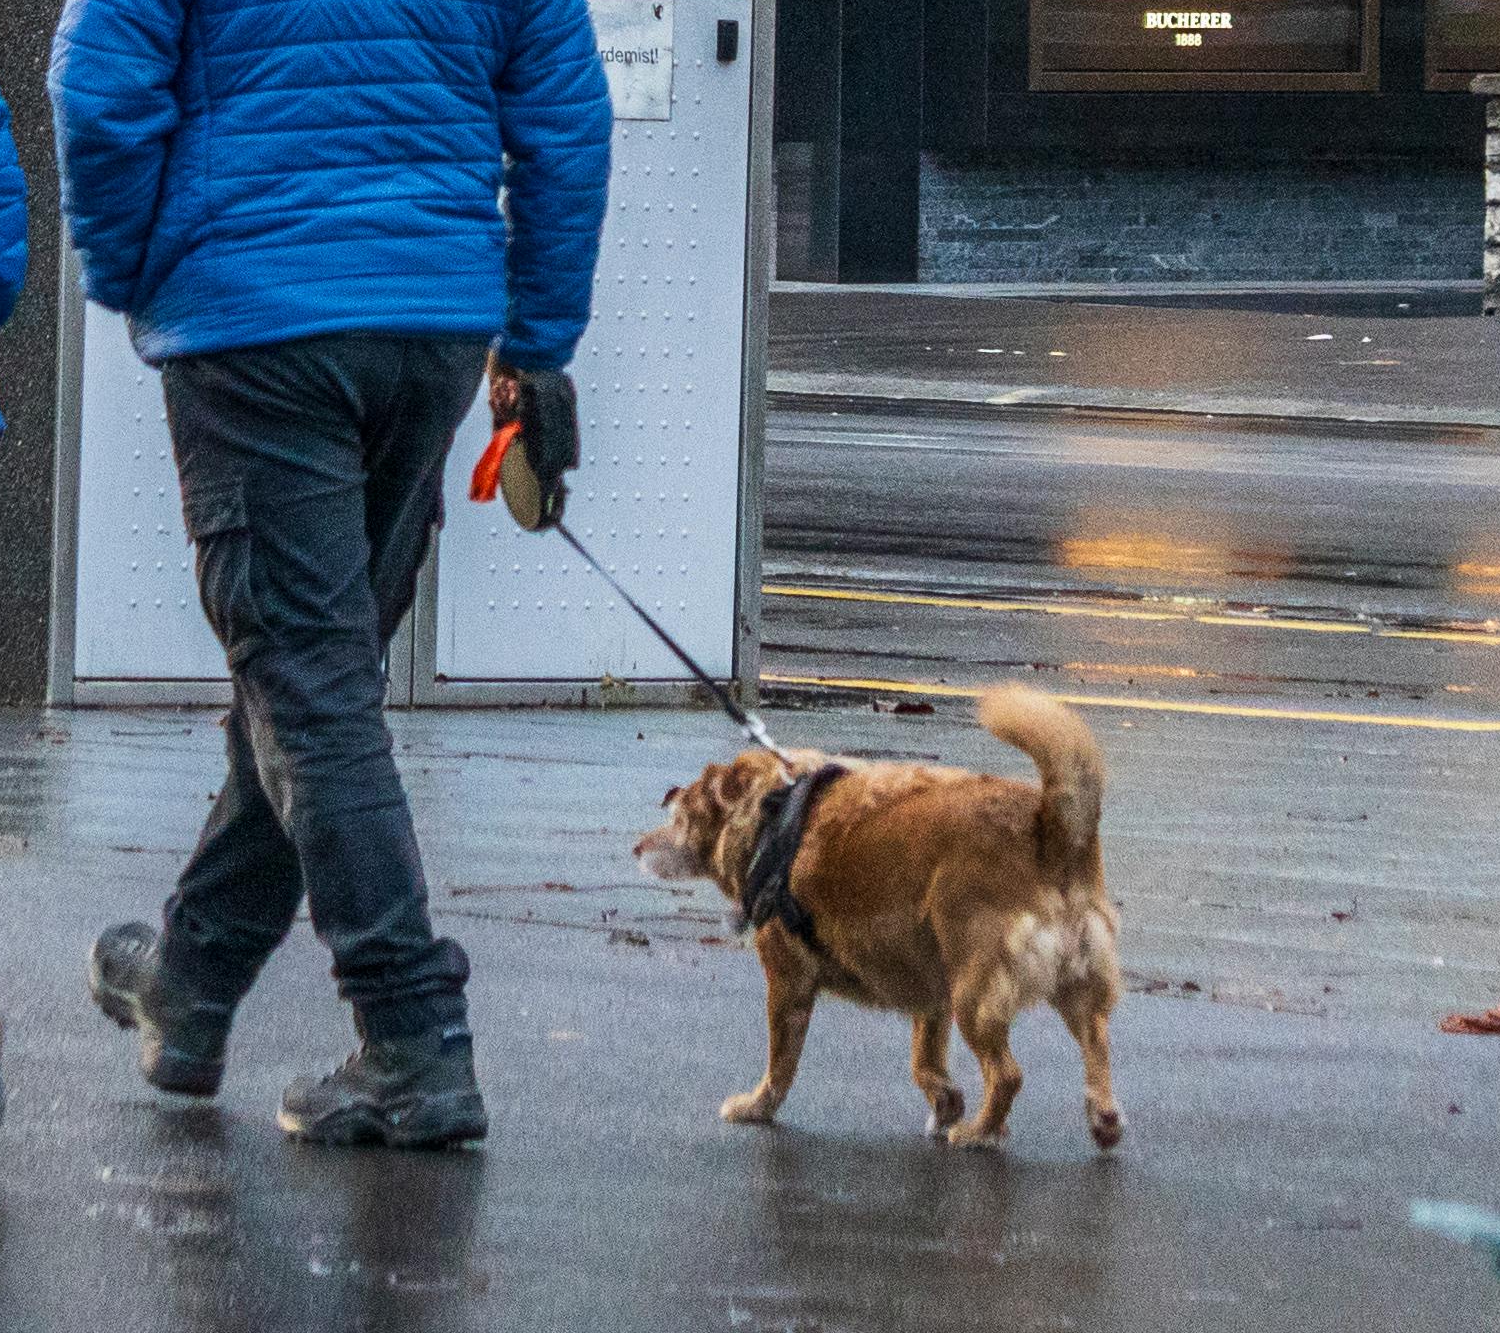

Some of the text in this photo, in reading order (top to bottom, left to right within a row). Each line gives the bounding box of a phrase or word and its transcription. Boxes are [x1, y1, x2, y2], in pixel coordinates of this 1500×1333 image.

[1144, 11, 1233, 30] BUCHERER
[1174, 34, 1202, 47] 1888
[599, 48, 659, 65] rdemist!
